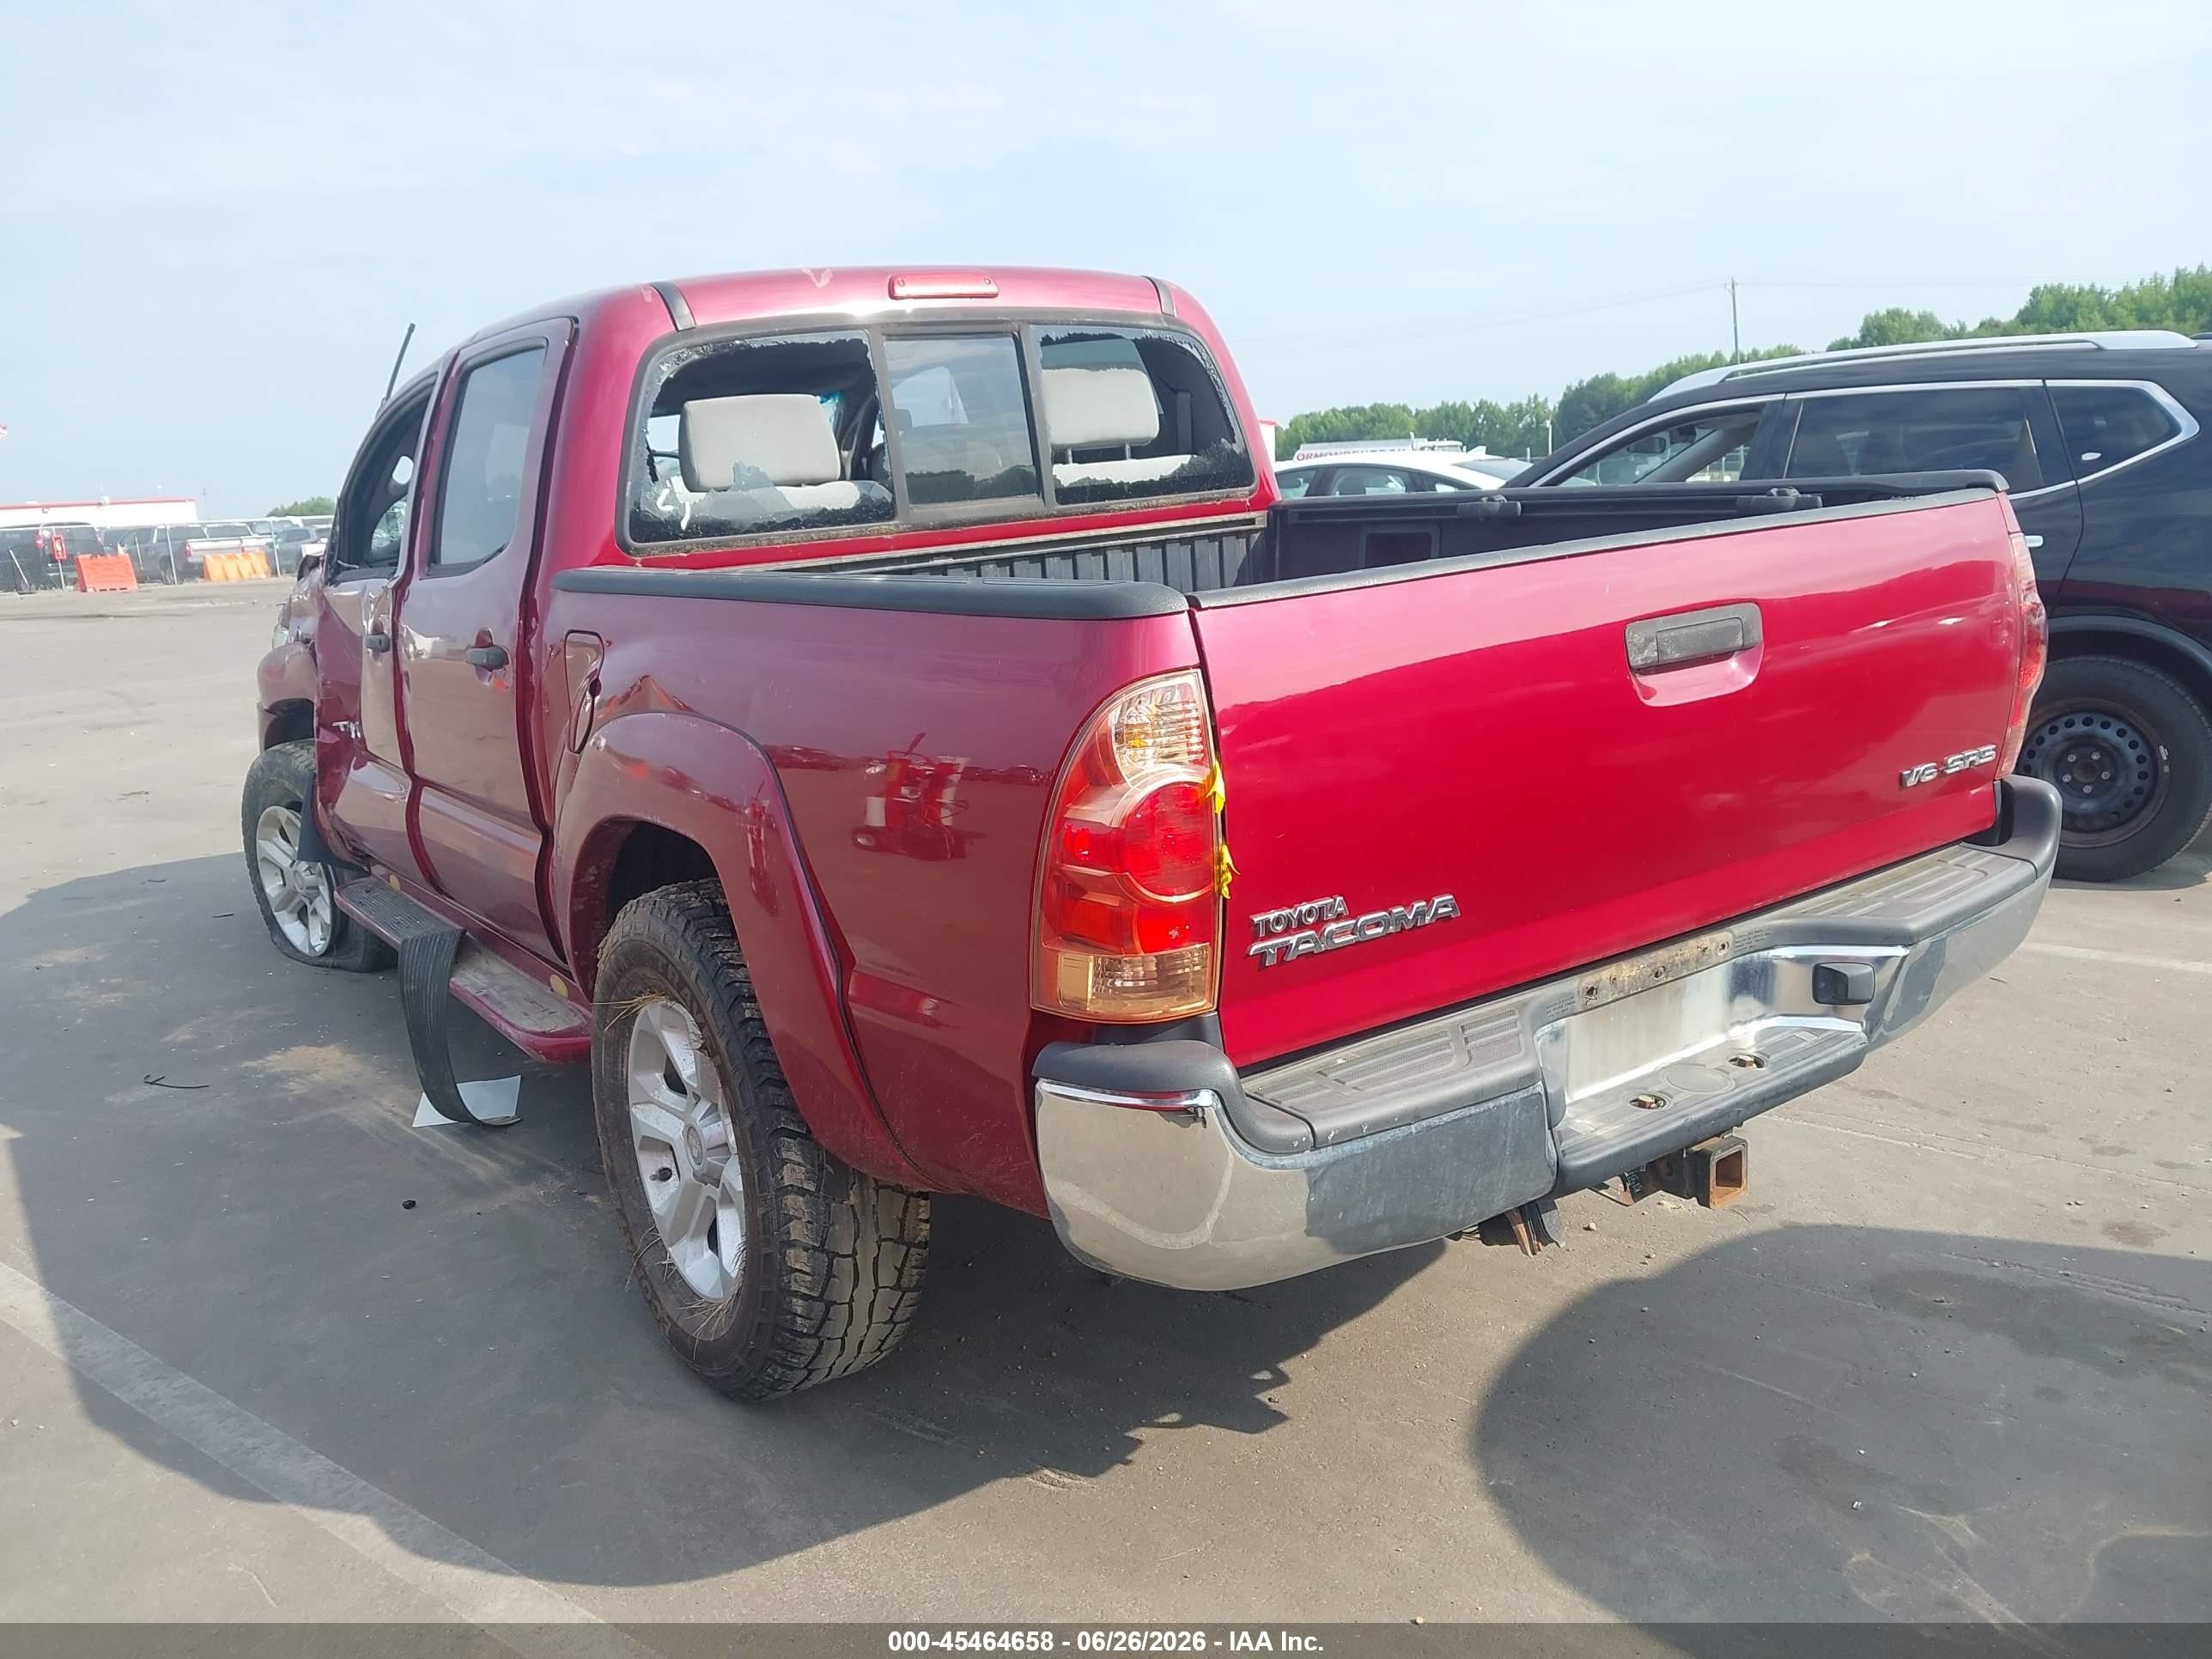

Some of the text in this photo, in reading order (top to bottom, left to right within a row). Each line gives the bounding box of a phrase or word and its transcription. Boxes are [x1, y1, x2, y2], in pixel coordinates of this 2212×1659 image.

[1899, 744, 1997, 787] V6 SR5
[1248, 893, 1462, 968] TACOMA
[1251, 895, 1349, 938] TOYOTA
